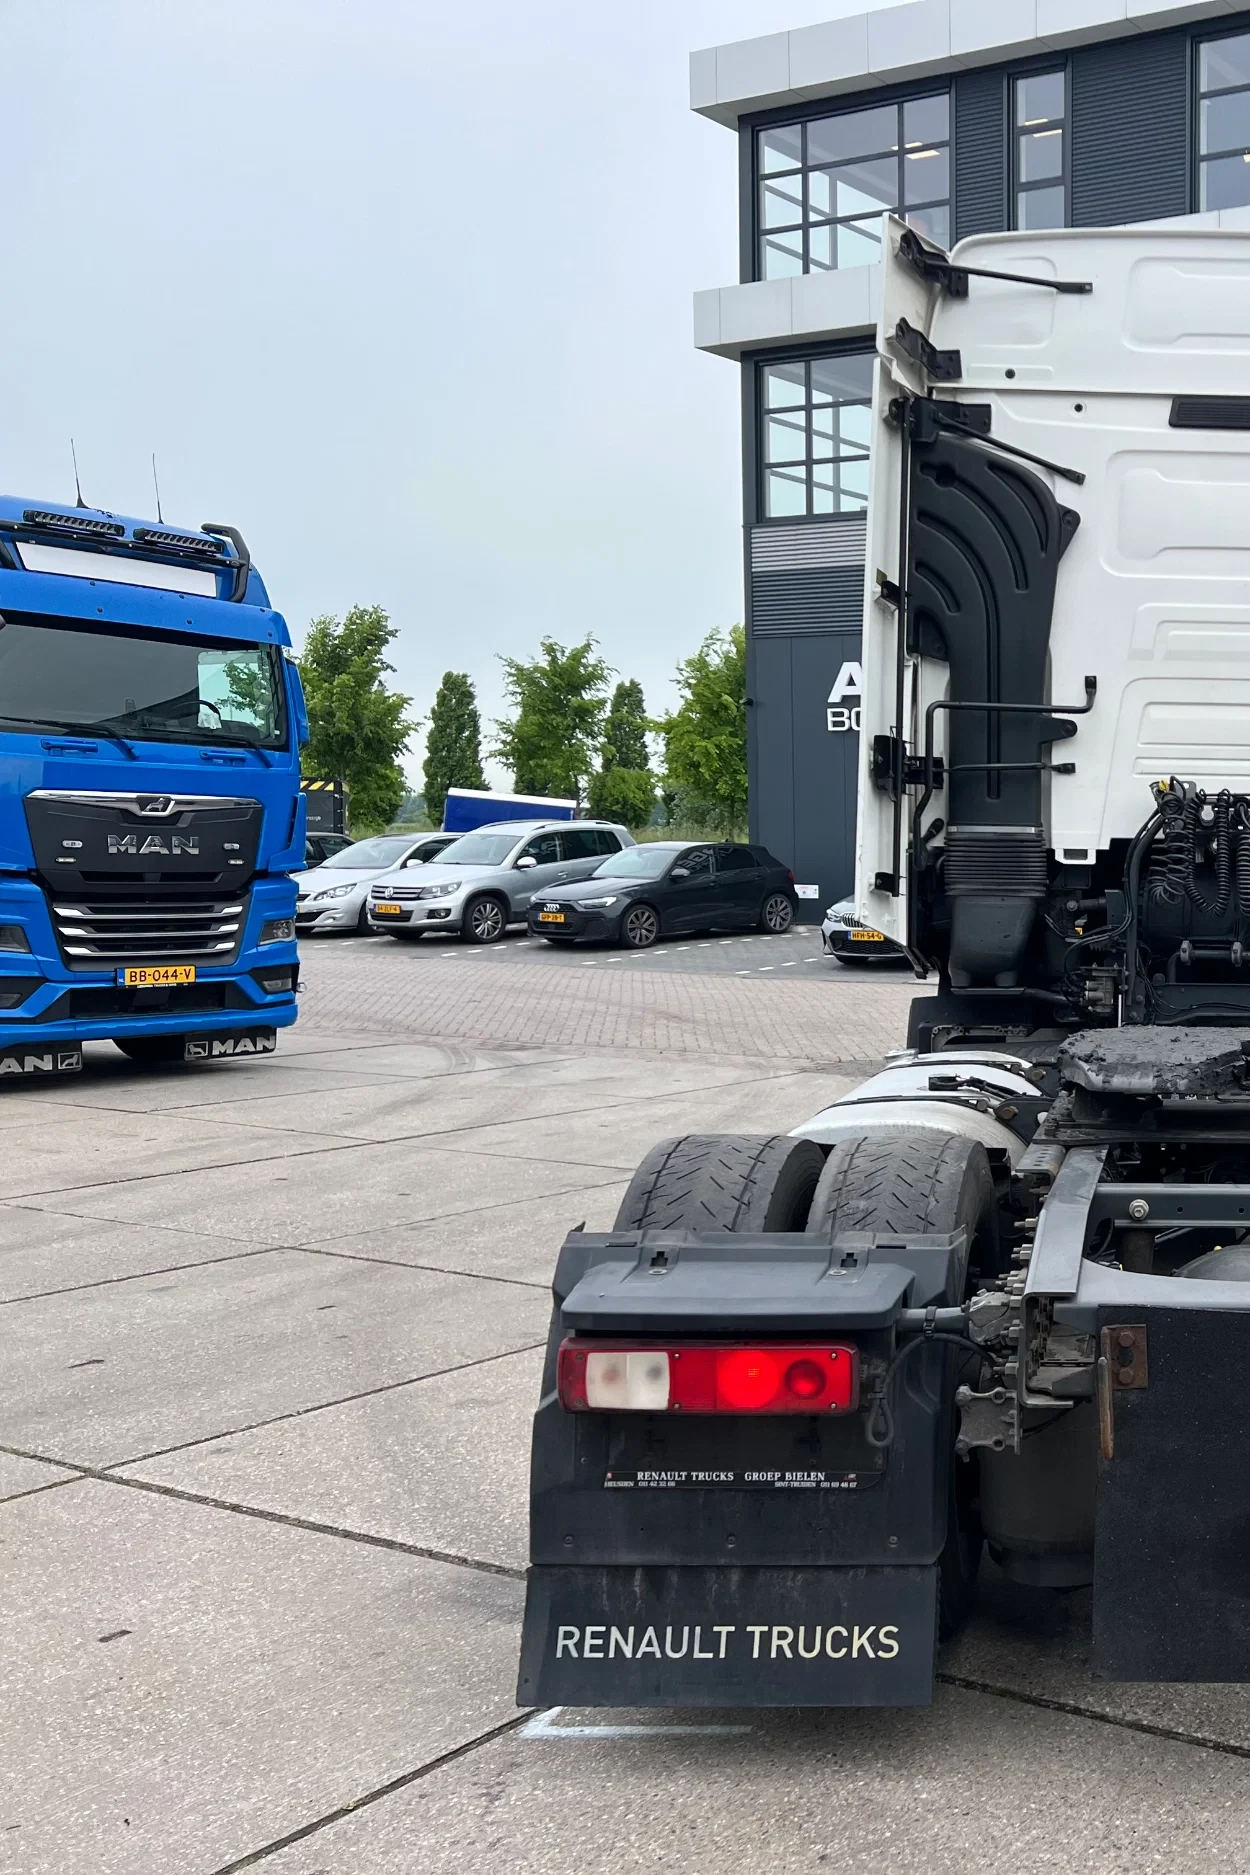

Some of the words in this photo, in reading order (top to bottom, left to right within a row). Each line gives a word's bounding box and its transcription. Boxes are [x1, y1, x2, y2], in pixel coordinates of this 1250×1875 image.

[107, 834, 200, 855] MAN
[129, 968, 192, 983] BB-044-V
[212, 1035, 276, 1056] MAN
[636, 1471, 688, 1481] RENAULT
[690, 1471, 734, 1481] TRUCKS
[744, 1471, 782, 1481] GROEP
[784, 1471, 826, 1481] BIELEN
[555, 1625, 736, 1659] RENAULT
[746, 1625, 900, 1659] TRUCKS
